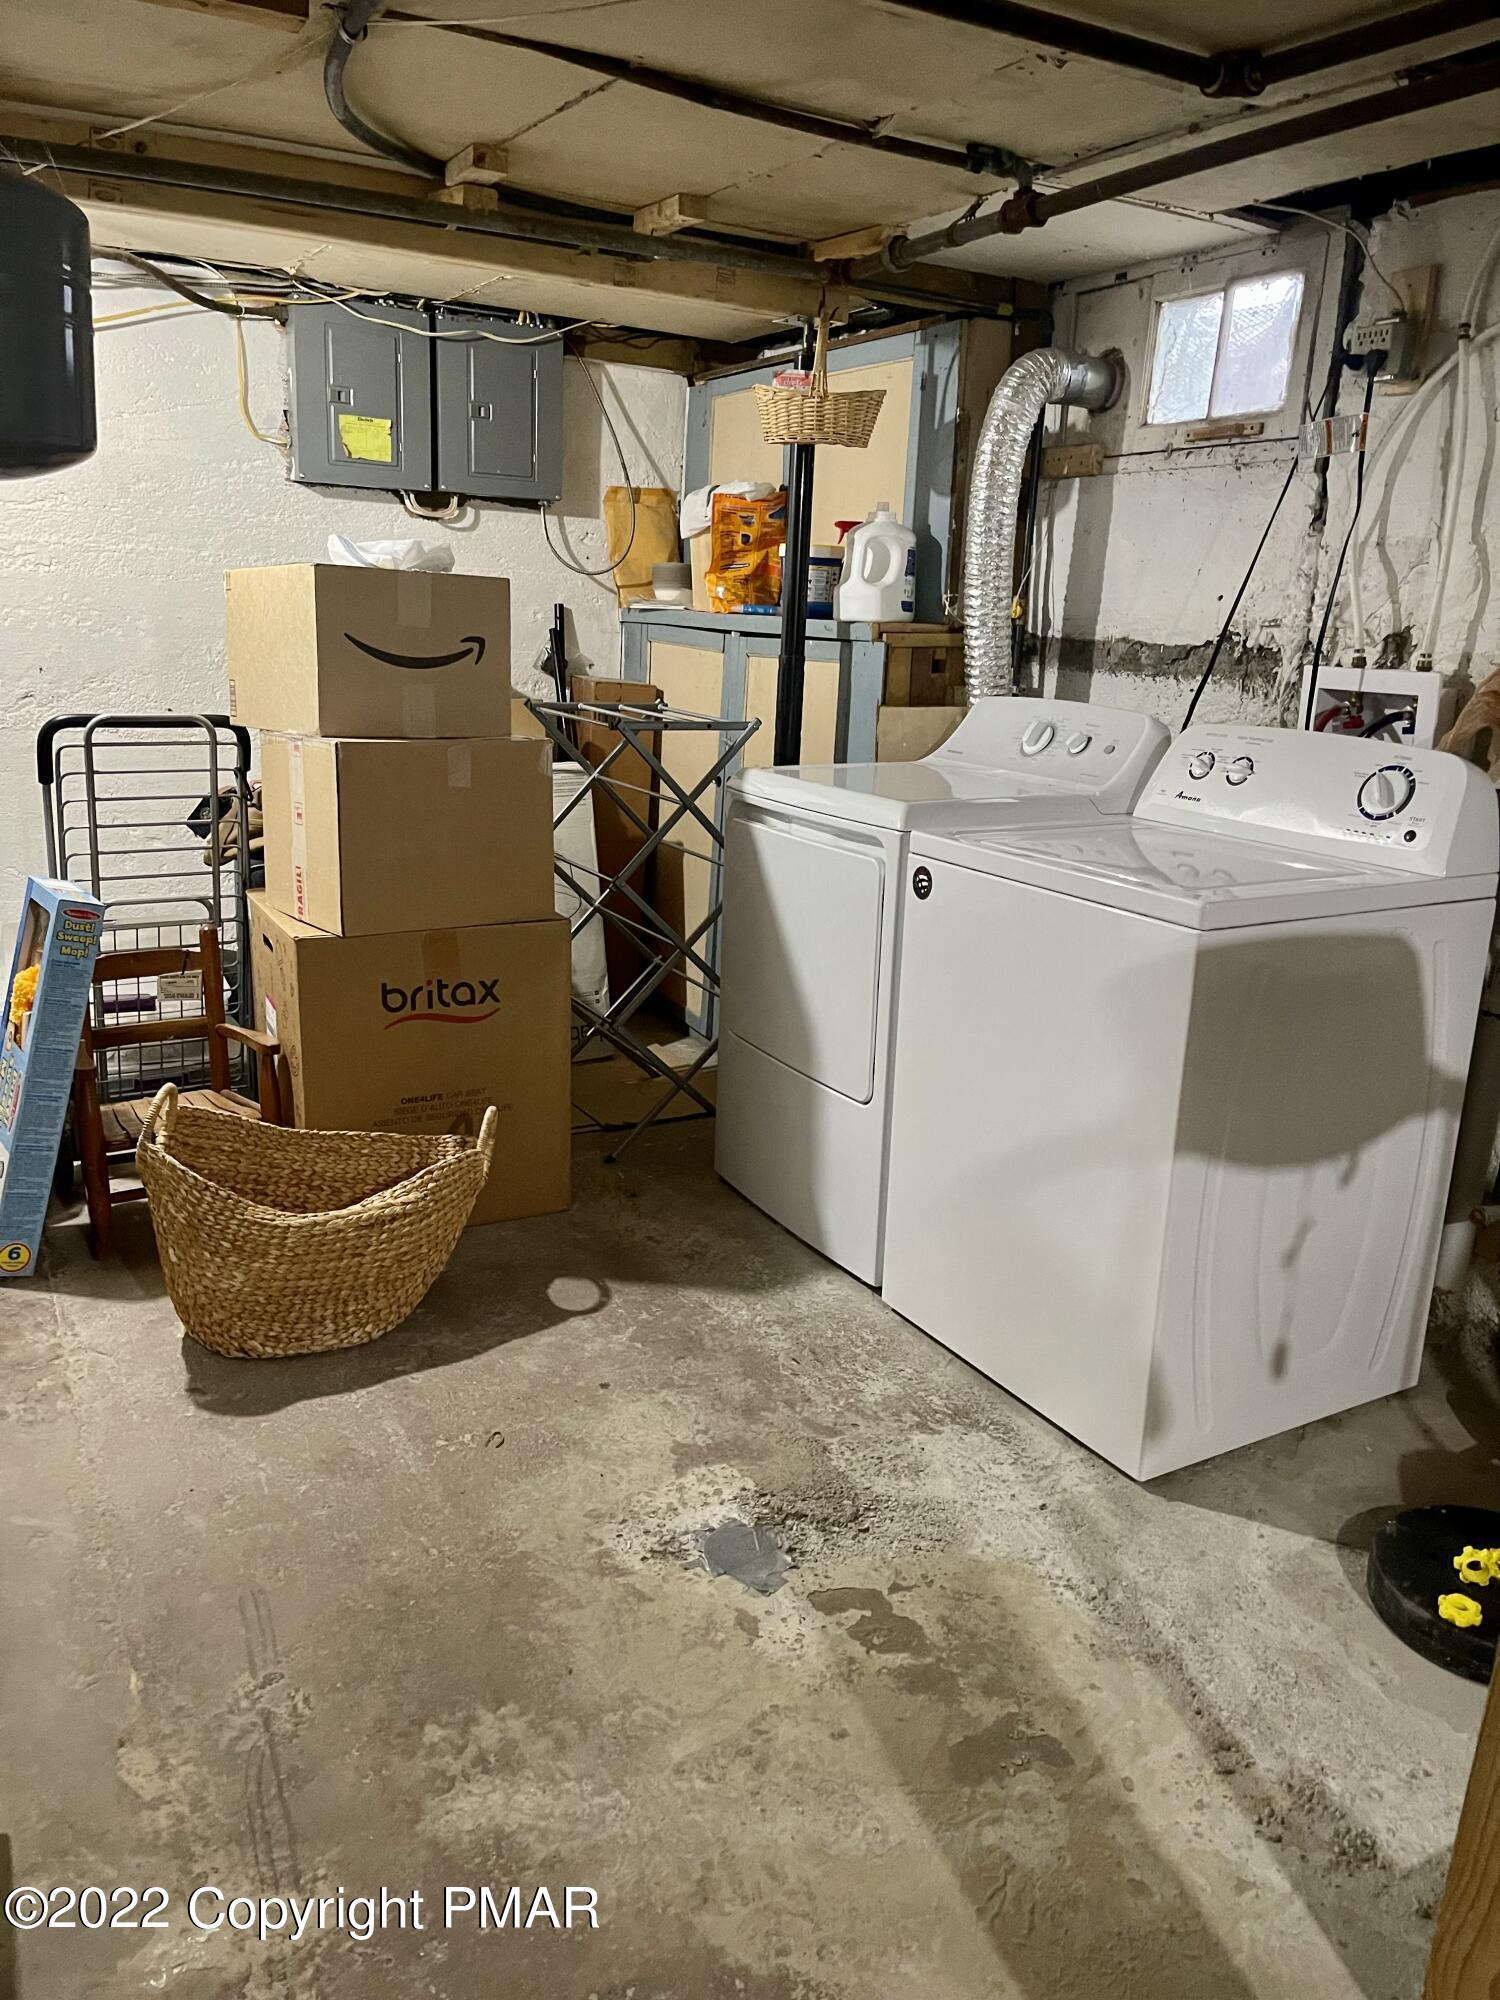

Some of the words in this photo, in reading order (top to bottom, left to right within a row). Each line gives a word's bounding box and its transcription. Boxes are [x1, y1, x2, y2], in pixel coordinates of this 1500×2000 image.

[1174, 790, 1202, 802] Amana
[64, 919, 95, 933] Dust!
[60, 945, 88, 960] Mop!
[381, 978, 501, 1013] britax
[400, 1093, 444, 1105] ONE4LIFE
[8, 1246, 22, 1261] 6
